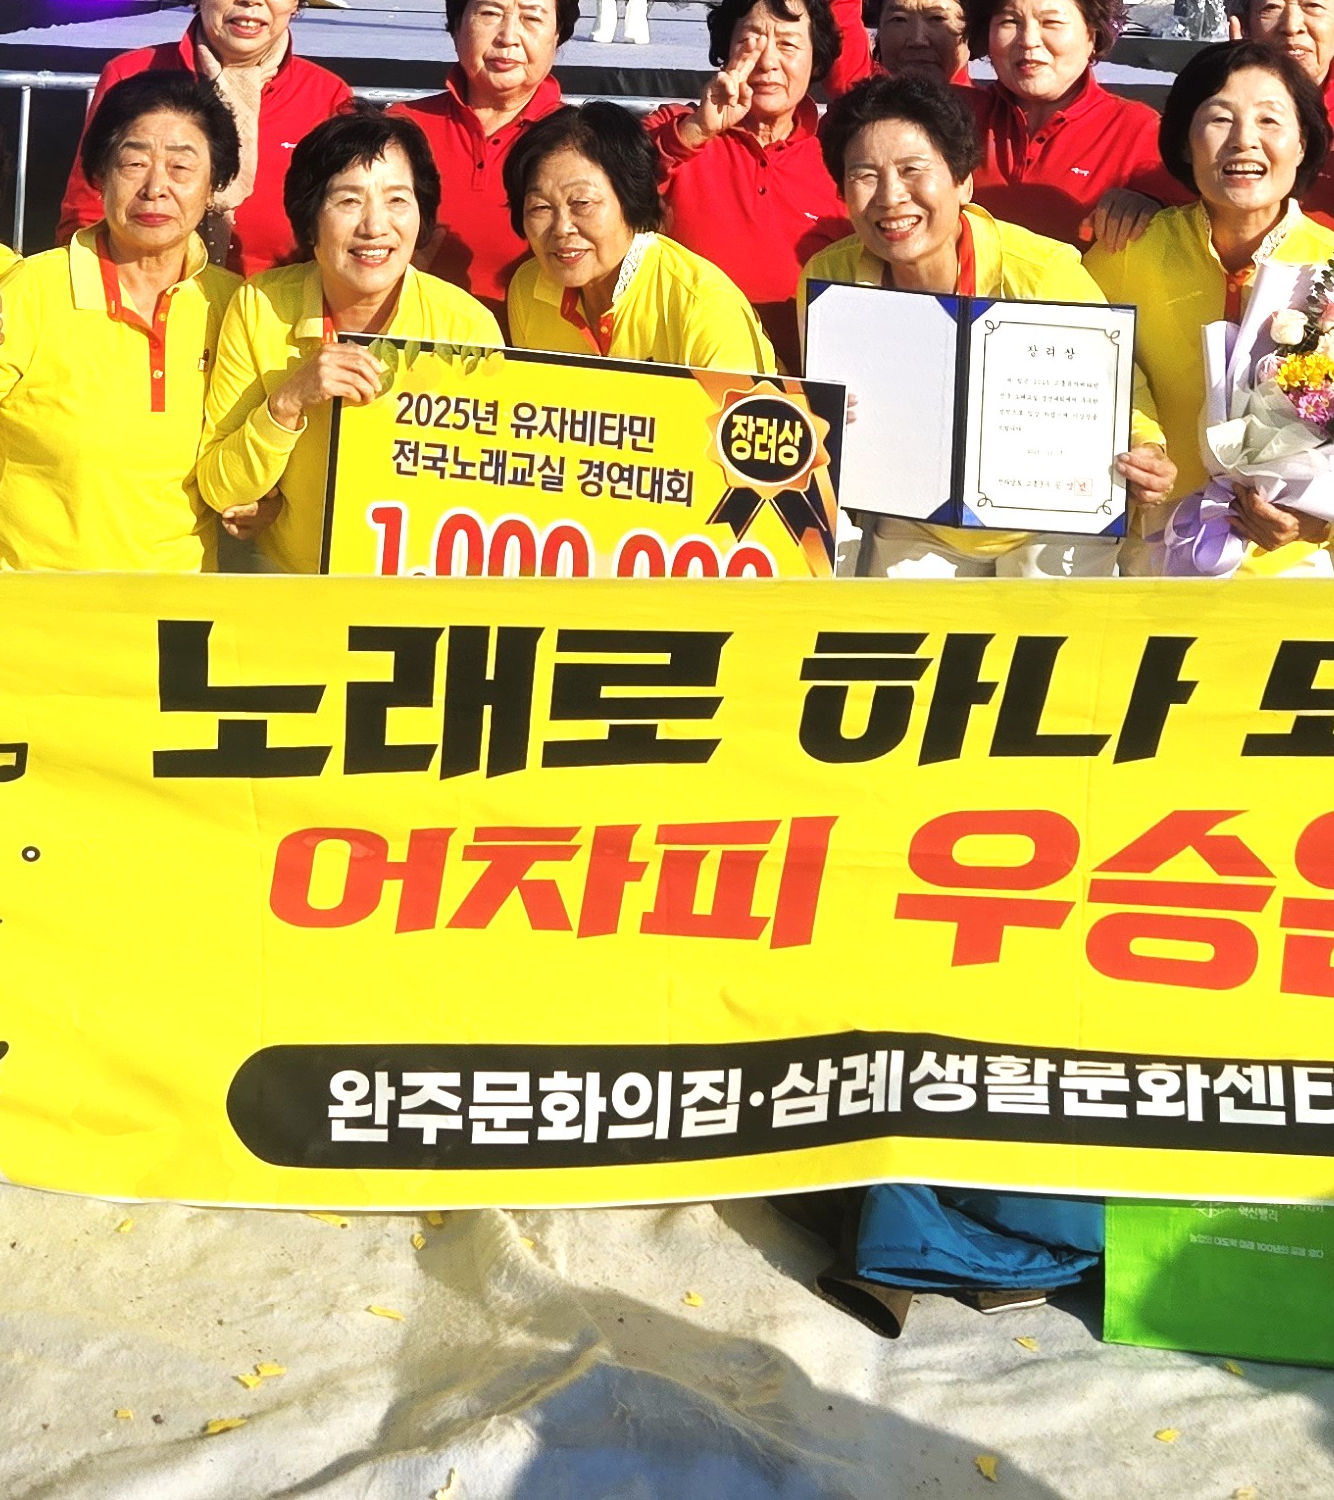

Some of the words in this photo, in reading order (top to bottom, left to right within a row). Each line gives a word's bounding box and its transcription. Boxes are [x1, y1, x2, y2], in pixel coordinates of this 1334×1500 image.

[394, 391, 499, 437] 2025년
[510, 402, 656, 454] 유자비타민
[730, 413, 803, 467] 장려상
[391, 439, 566, 494] 전국노래교실
[577, 458, 695, 508] 경연대회
[153, 620, 734, 780] 노래로
[798, 631, 1199, 767] 하나
[269, 815, 838, 950] 어차피
